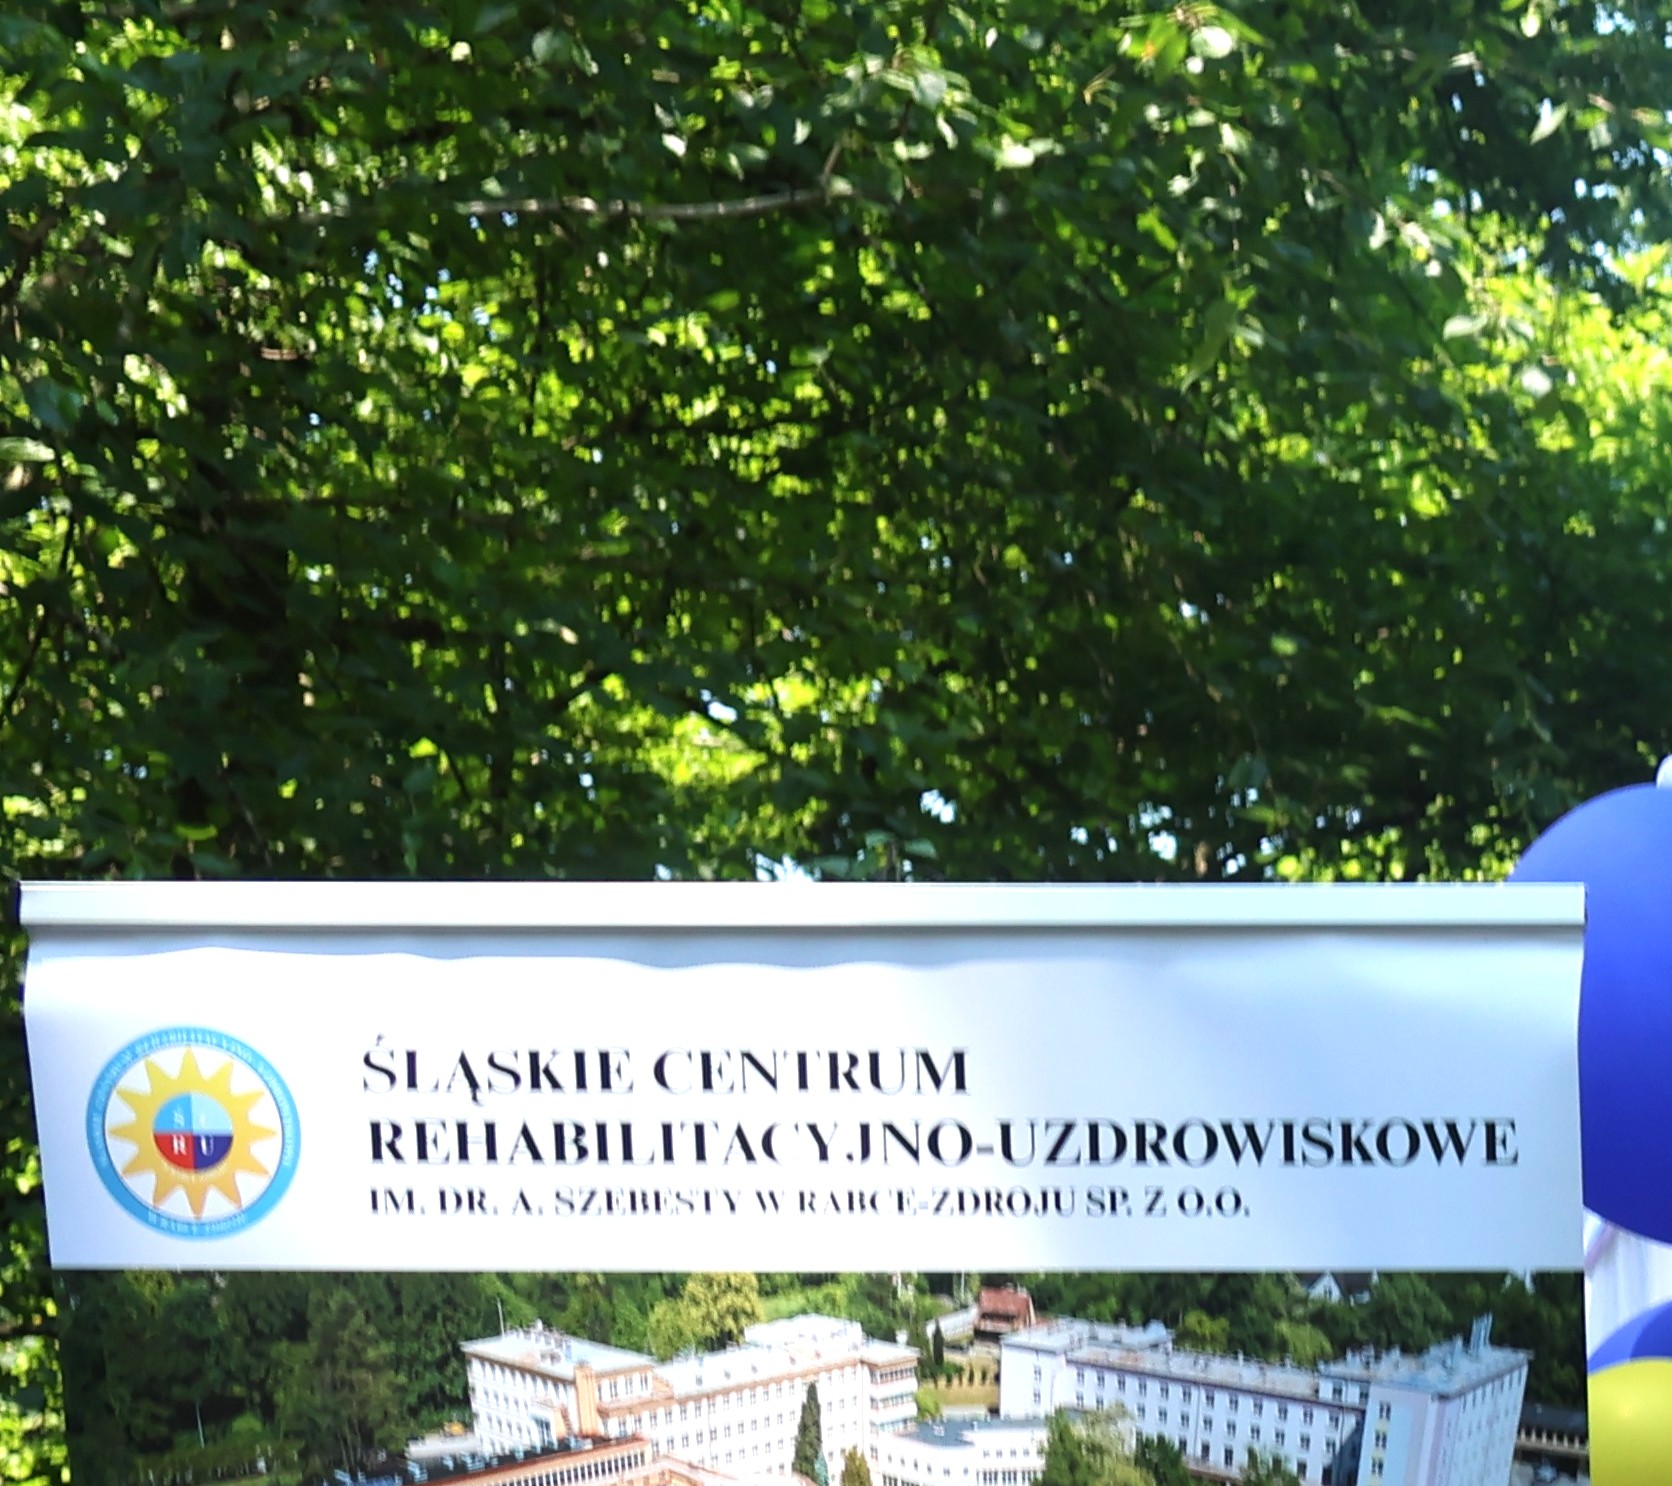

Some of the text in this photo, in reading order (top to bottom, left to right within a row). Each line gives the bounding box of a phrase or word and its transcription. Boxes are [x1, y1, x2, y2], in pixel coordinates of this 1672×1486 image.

[361, 1033, 970, 1108] ŚLĄSKIE CENTRUM
[367, 1118, 1520, 1168] REHABILITACYJNO-UZDROWISKOWE
[369, 1187, 426, 1218] IM.
[438, 1187, 499, 1218] DR.
[512, 1187, 543, 1218] A.
[554, 1187, 742, 1218] SZEBESTY
[754, 1187, 785, 1218] W
[1085, 1187, 1133, 1218] SP.
[1143, 1187, 1167, 1218] Z
[1177, 1187, 1251, 1218] O.O.
